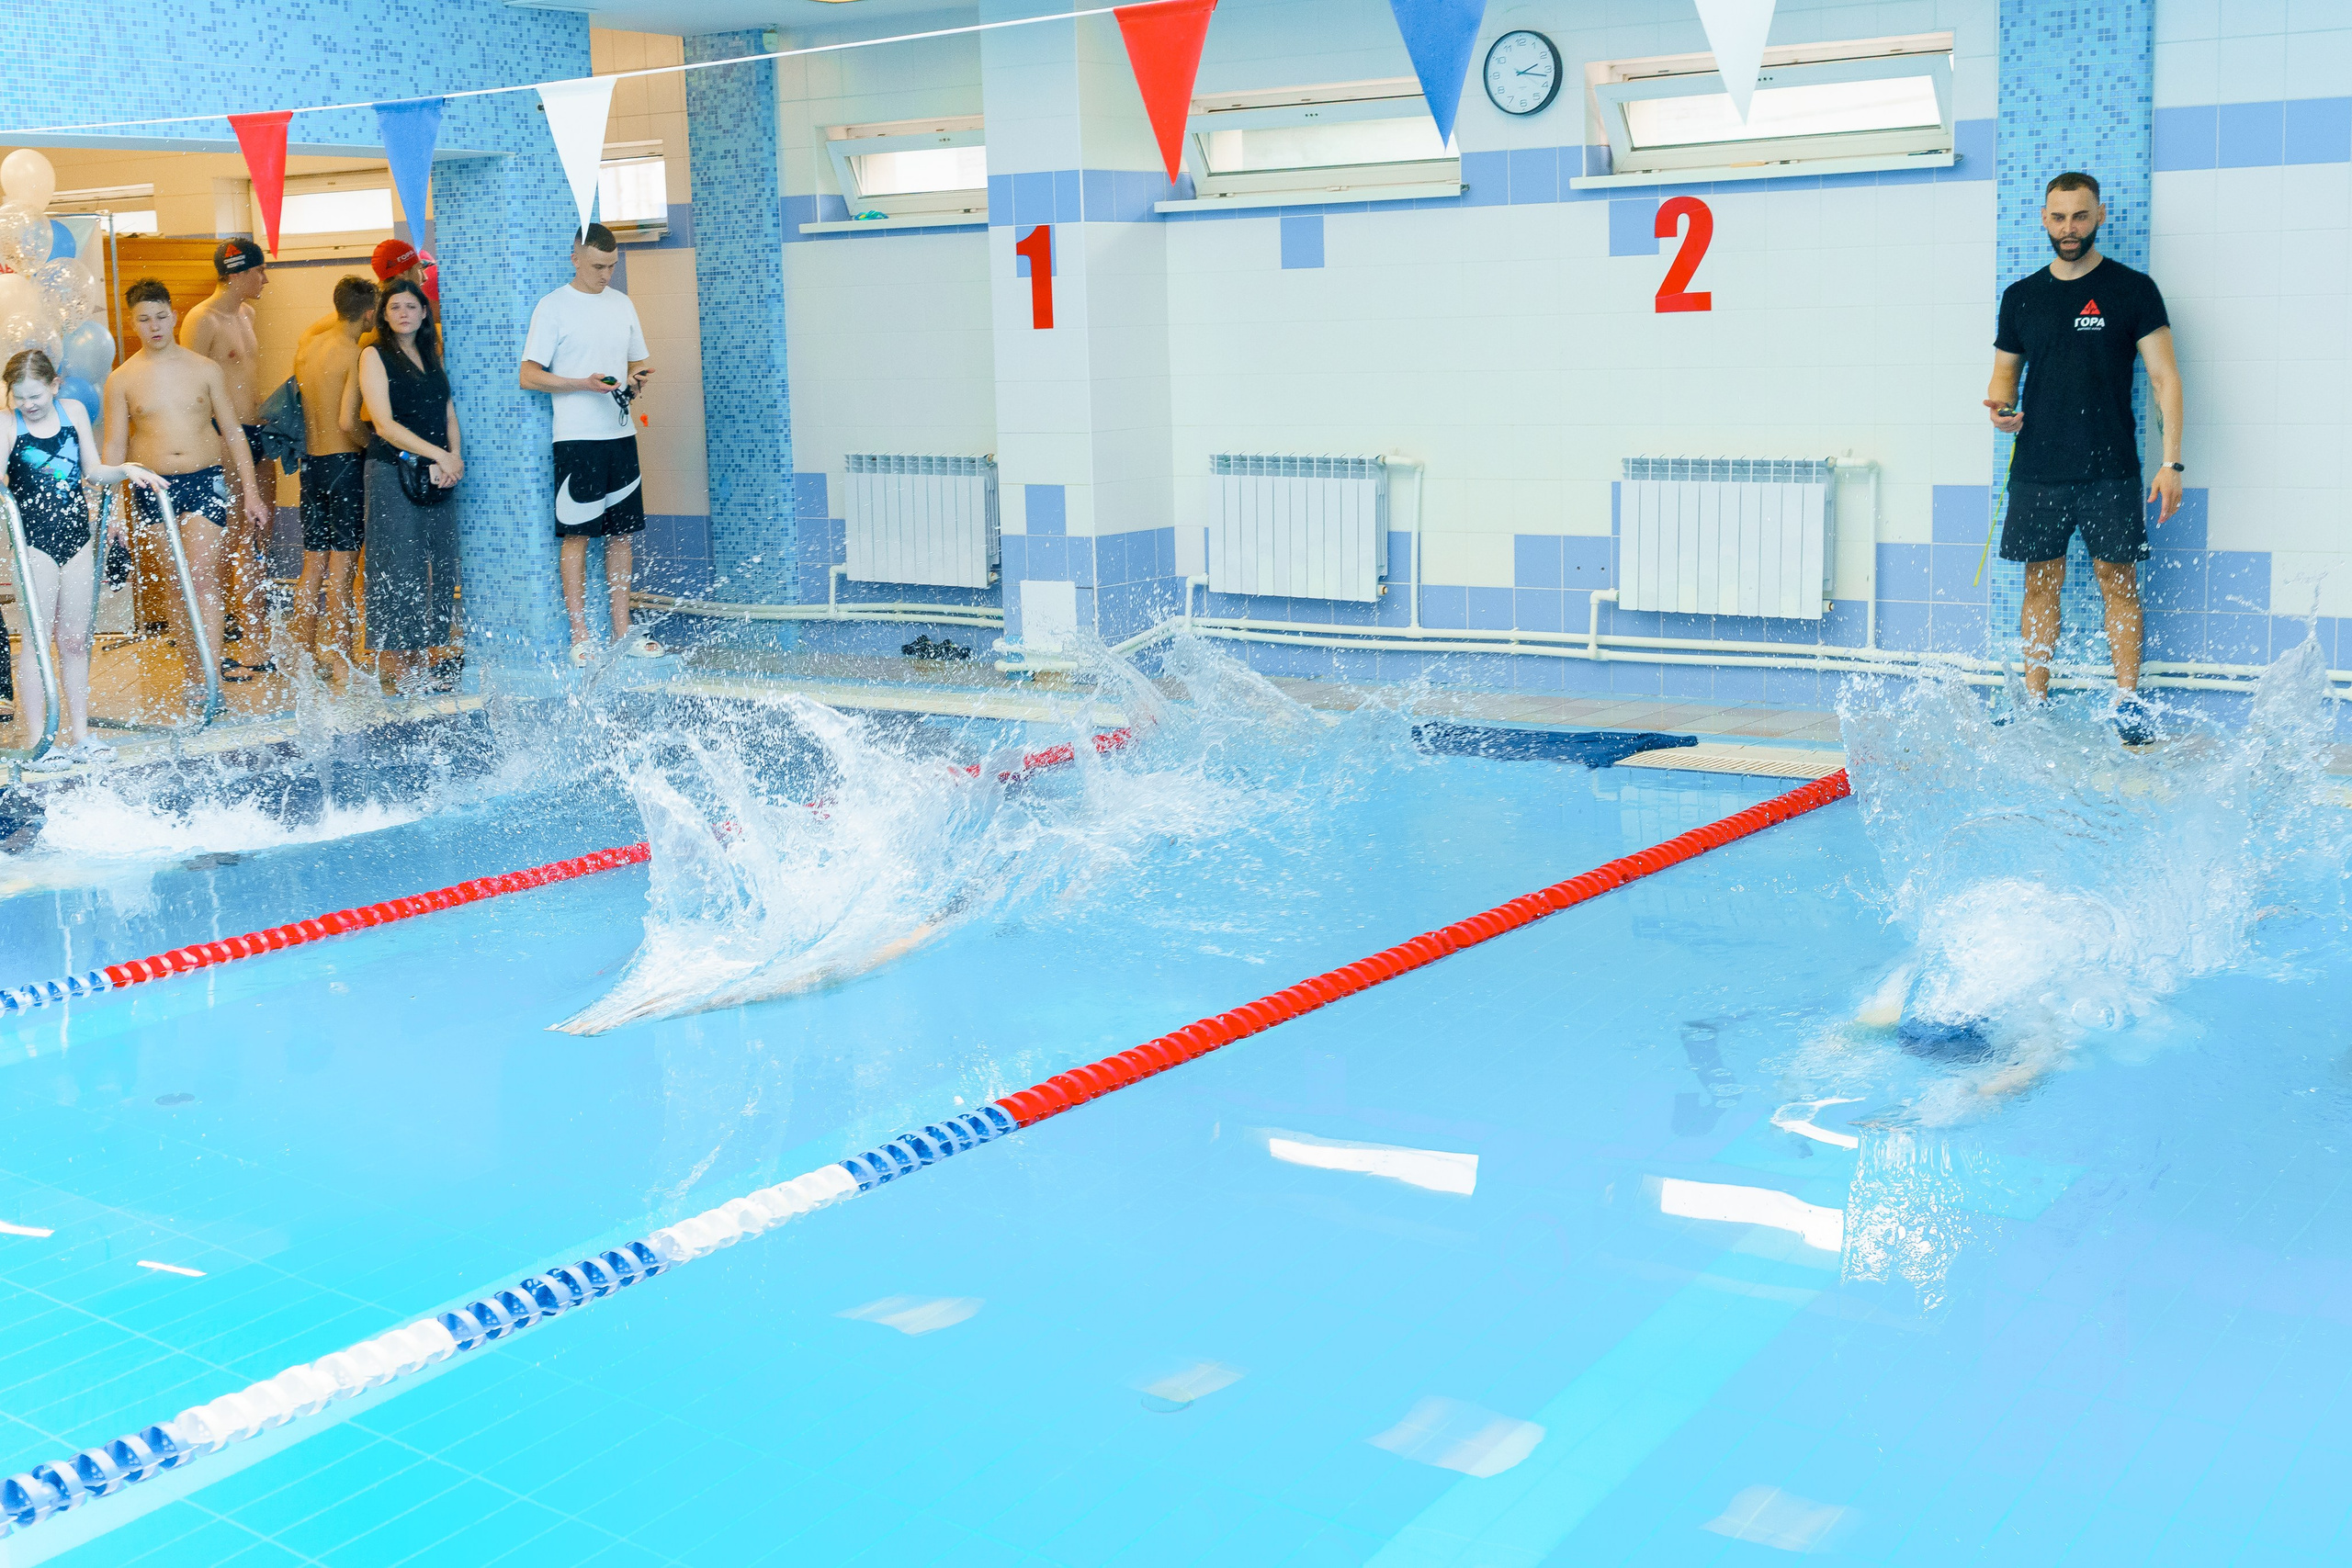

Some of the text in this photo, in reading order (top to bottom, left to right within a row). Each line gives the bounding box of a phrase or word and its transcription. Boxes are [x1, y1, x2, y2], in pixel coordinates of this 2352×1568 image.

[1515, 38, 1526, 46] 12
[1540, 51, 1548, 60] 2
[1496, 56, 1507, 64] 10
[1544, 65, 1552, 73] 3
[1493, 72, 1500, 80] 9
[1507, 96, 1515, 104] 7
[1520, 99, 1528, 107] 6
[1655, 196, 1713, 313] 2
[1016, 224, 1054, 329] 1
[2074, 317, 2105, 327] ГОРА
